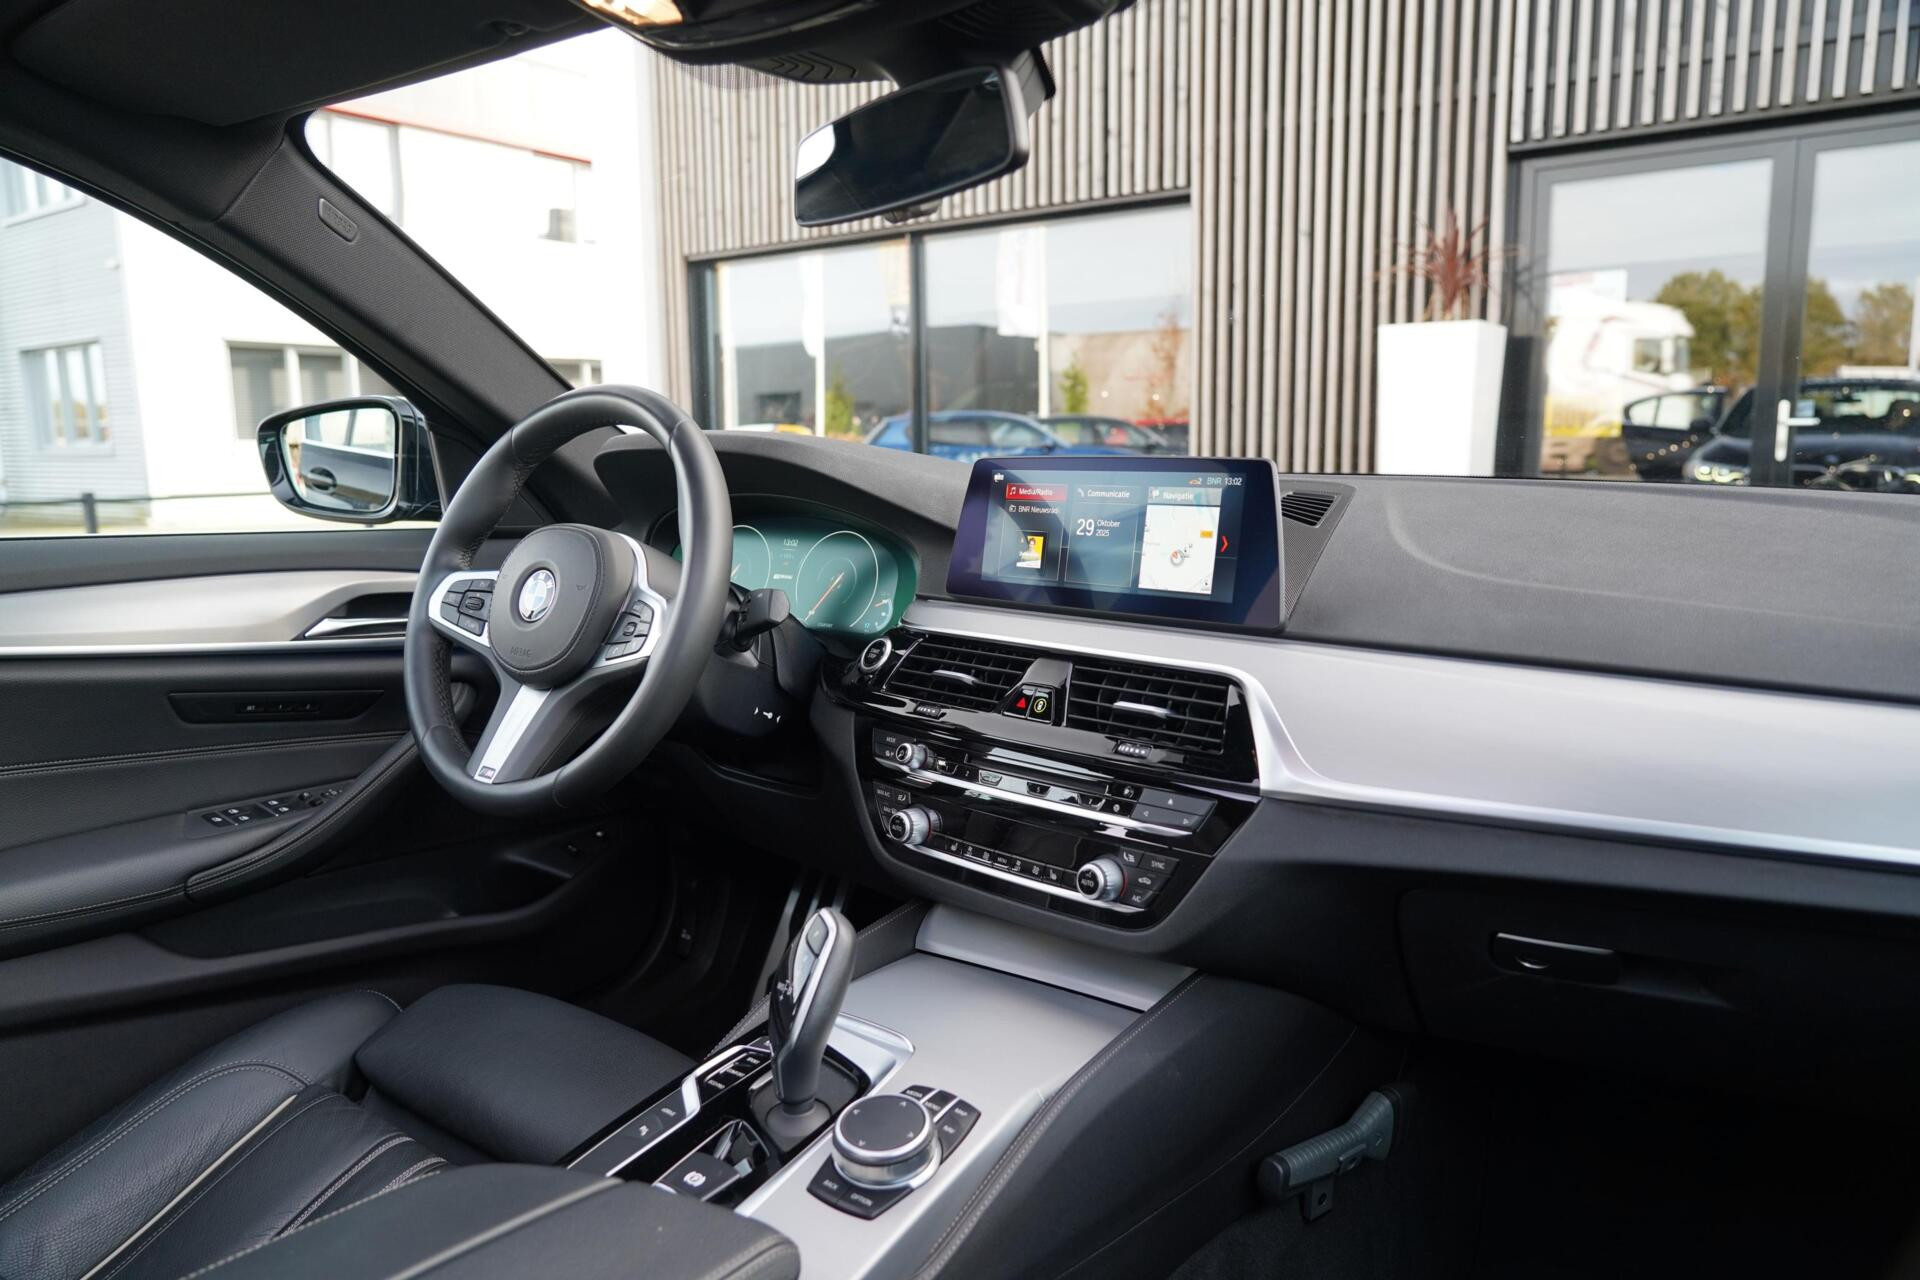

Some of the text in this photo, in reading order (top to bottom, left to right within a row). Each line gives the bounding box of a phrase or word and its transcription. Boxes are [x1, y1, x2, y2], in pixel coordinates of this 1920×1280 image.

[1224, 477, 1242, 486] 13:02
[1019, 487, 1053, 496] Media/Radio
[1087, 489, 1130, 498] Communicatie
[1163, 491, 1194, 501] Navigatie
[1076, 518, 1095, 536] 29
[1097, 519, 1120, 528] Oktober
[1081, 879, 1095, 888] AUTO
[822, 1178, 839, 1191] BACK
[850, 1192, 873, 1207] OPTION
